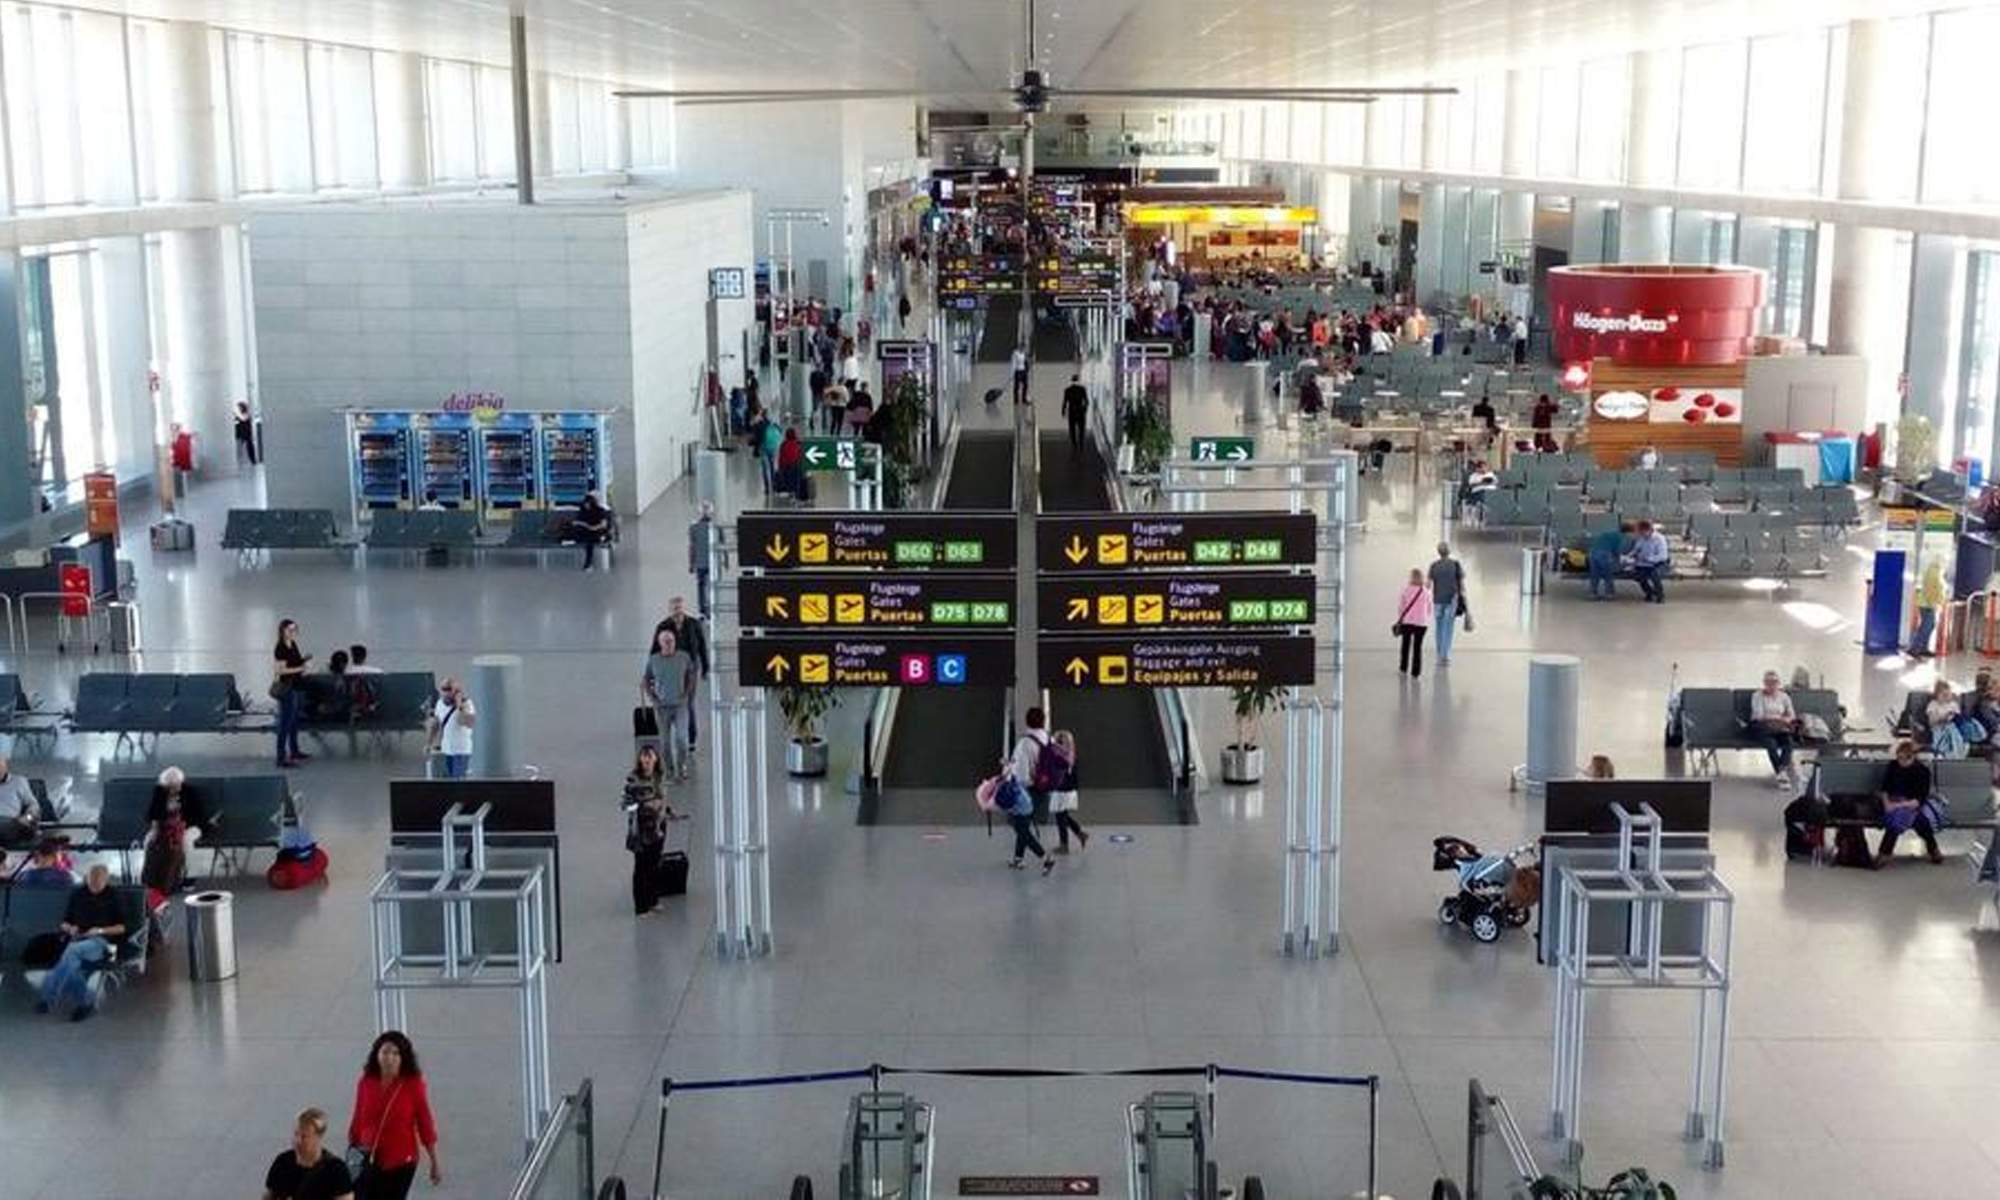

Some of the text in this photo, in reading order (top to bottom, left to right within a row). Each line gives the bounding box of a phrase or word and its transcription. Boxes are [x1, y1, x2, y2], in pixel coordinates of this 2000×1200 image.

[834, 535, 866, 546] Gates
[1133, 535, 1165, 547] Gates
[834, 549, 888, 561] Puertas
[898, 545, 931, 558] D60
[949, 545, 979, 558] D63
[1133, 549, 1187, 561] Puertas
[1199, 545, 1231, 558] D42
[870, 595, 902, 607] Gates
[1170, 596, 1201, 607] Gates
[871, 609, 924, 621] Puertas
[935, 606, 965, 618] D75
[1170, 609, 1222, 621] Puertas
[1231, 604, 1304, 618] D70 D74
[835, 656, 866, 667] Gates
[1185, 657, 1205, 667] and
[908, 659, 959, 678] B C
[835, 669, 889, 682] Puertas
[1134, 669, 1259, 684] Equipajes y Salida
